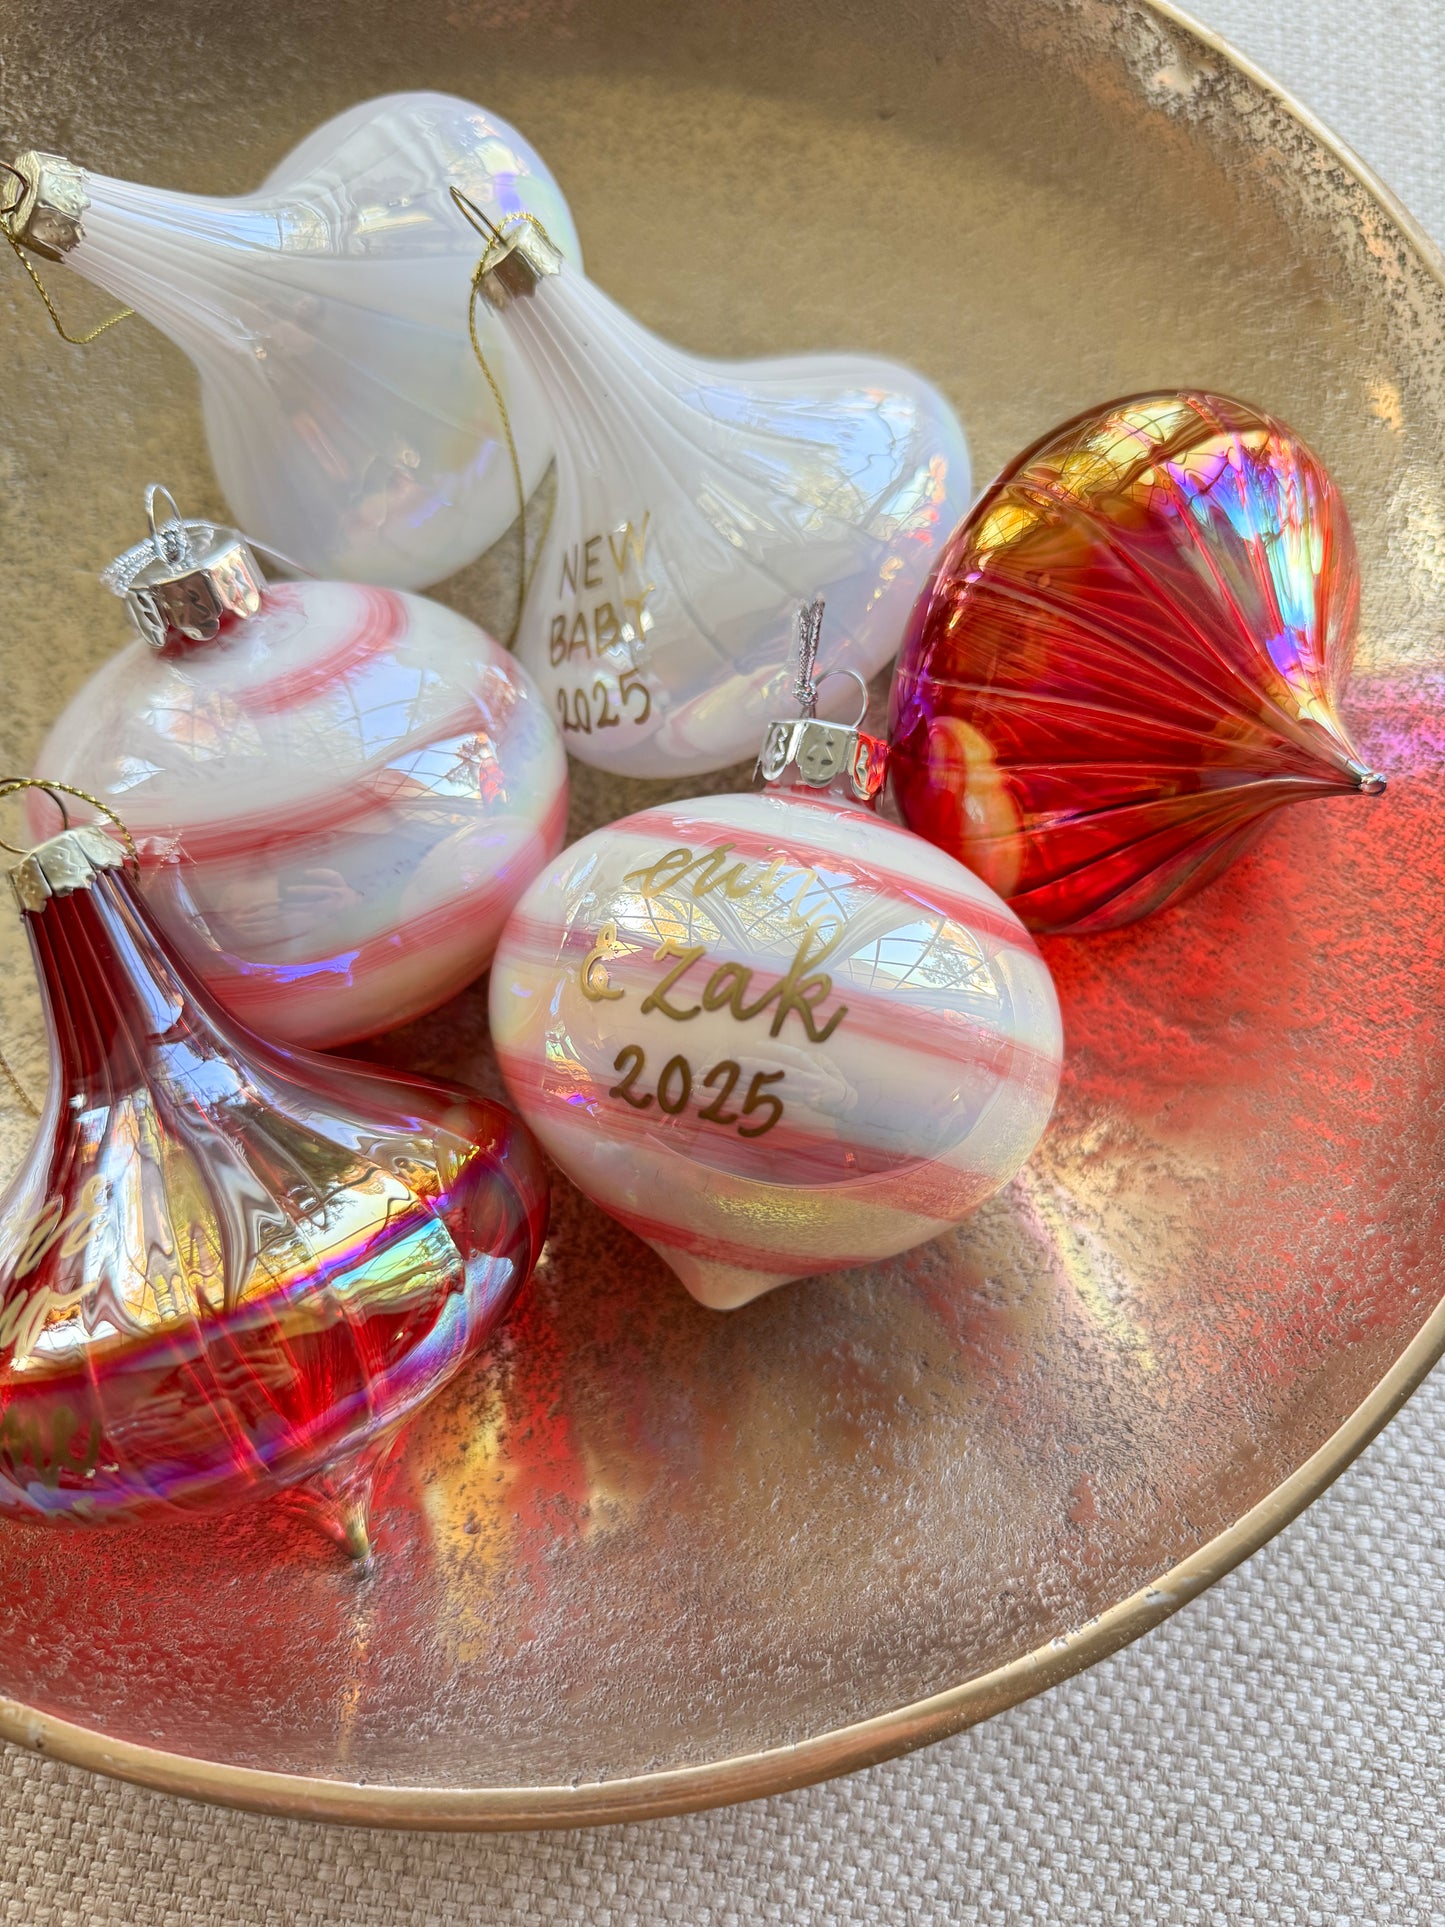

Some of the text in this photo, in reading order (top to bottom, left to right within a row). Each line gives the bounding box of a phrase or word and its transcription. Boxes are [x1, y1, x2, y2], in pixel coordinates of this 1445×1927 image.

[559, 511, 650, 600] NEW
[550, 583, 656, 667] BABY
[557, 668, 651, 735] 2025
[609, 1044, 785, 1138] 2025
